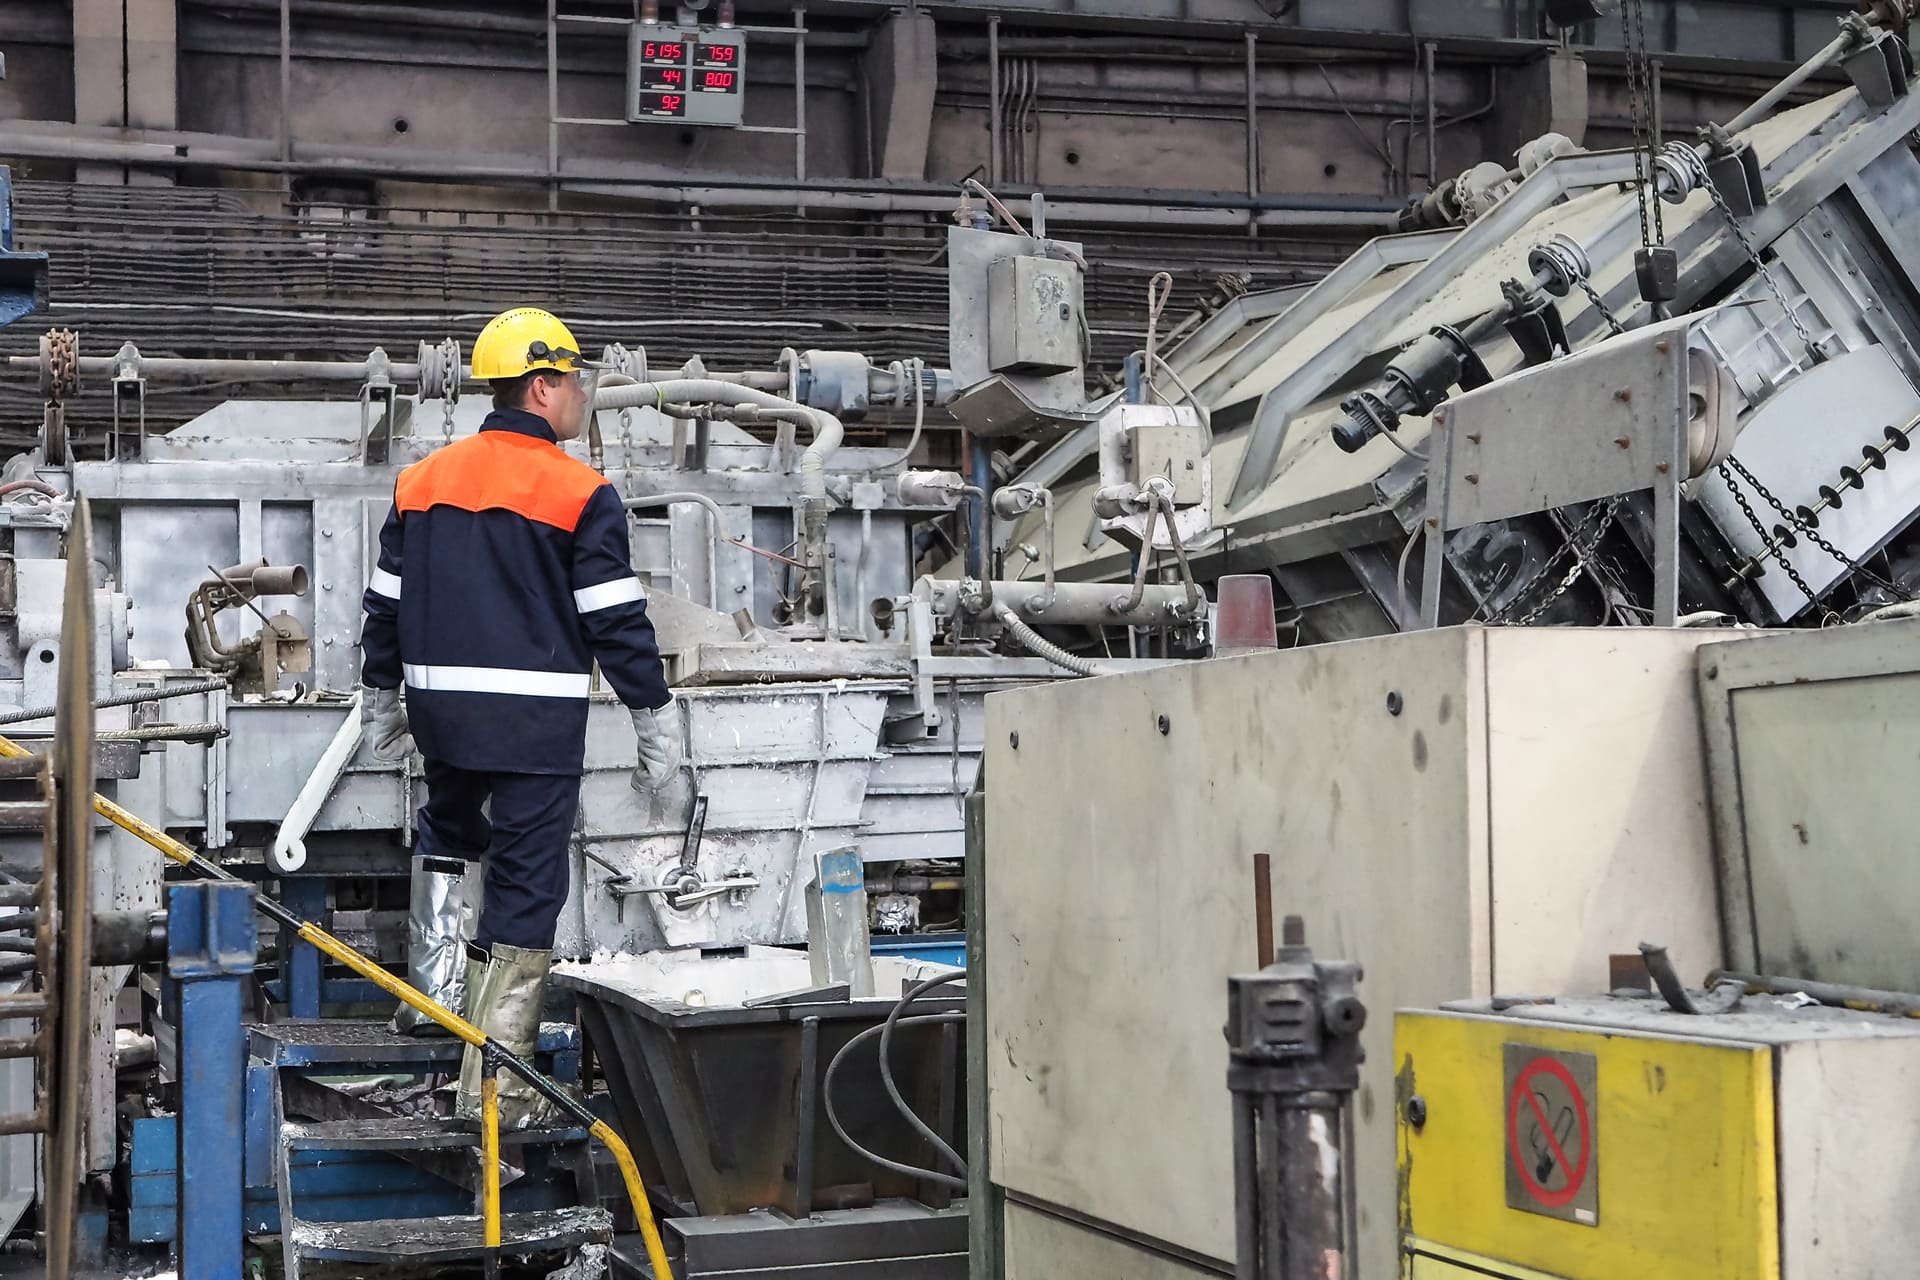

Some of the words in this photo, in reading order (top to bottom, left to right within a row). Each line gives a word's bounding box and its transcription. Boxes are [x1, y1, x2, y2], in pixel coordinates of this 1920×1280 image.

[645, 43, 681, 58] 6195
[709, 46, 734, 61] 759
[662, 70, 682, 83] 44
[705, 72, 733, 86] 800
[662, 95, 681, 110] 92
